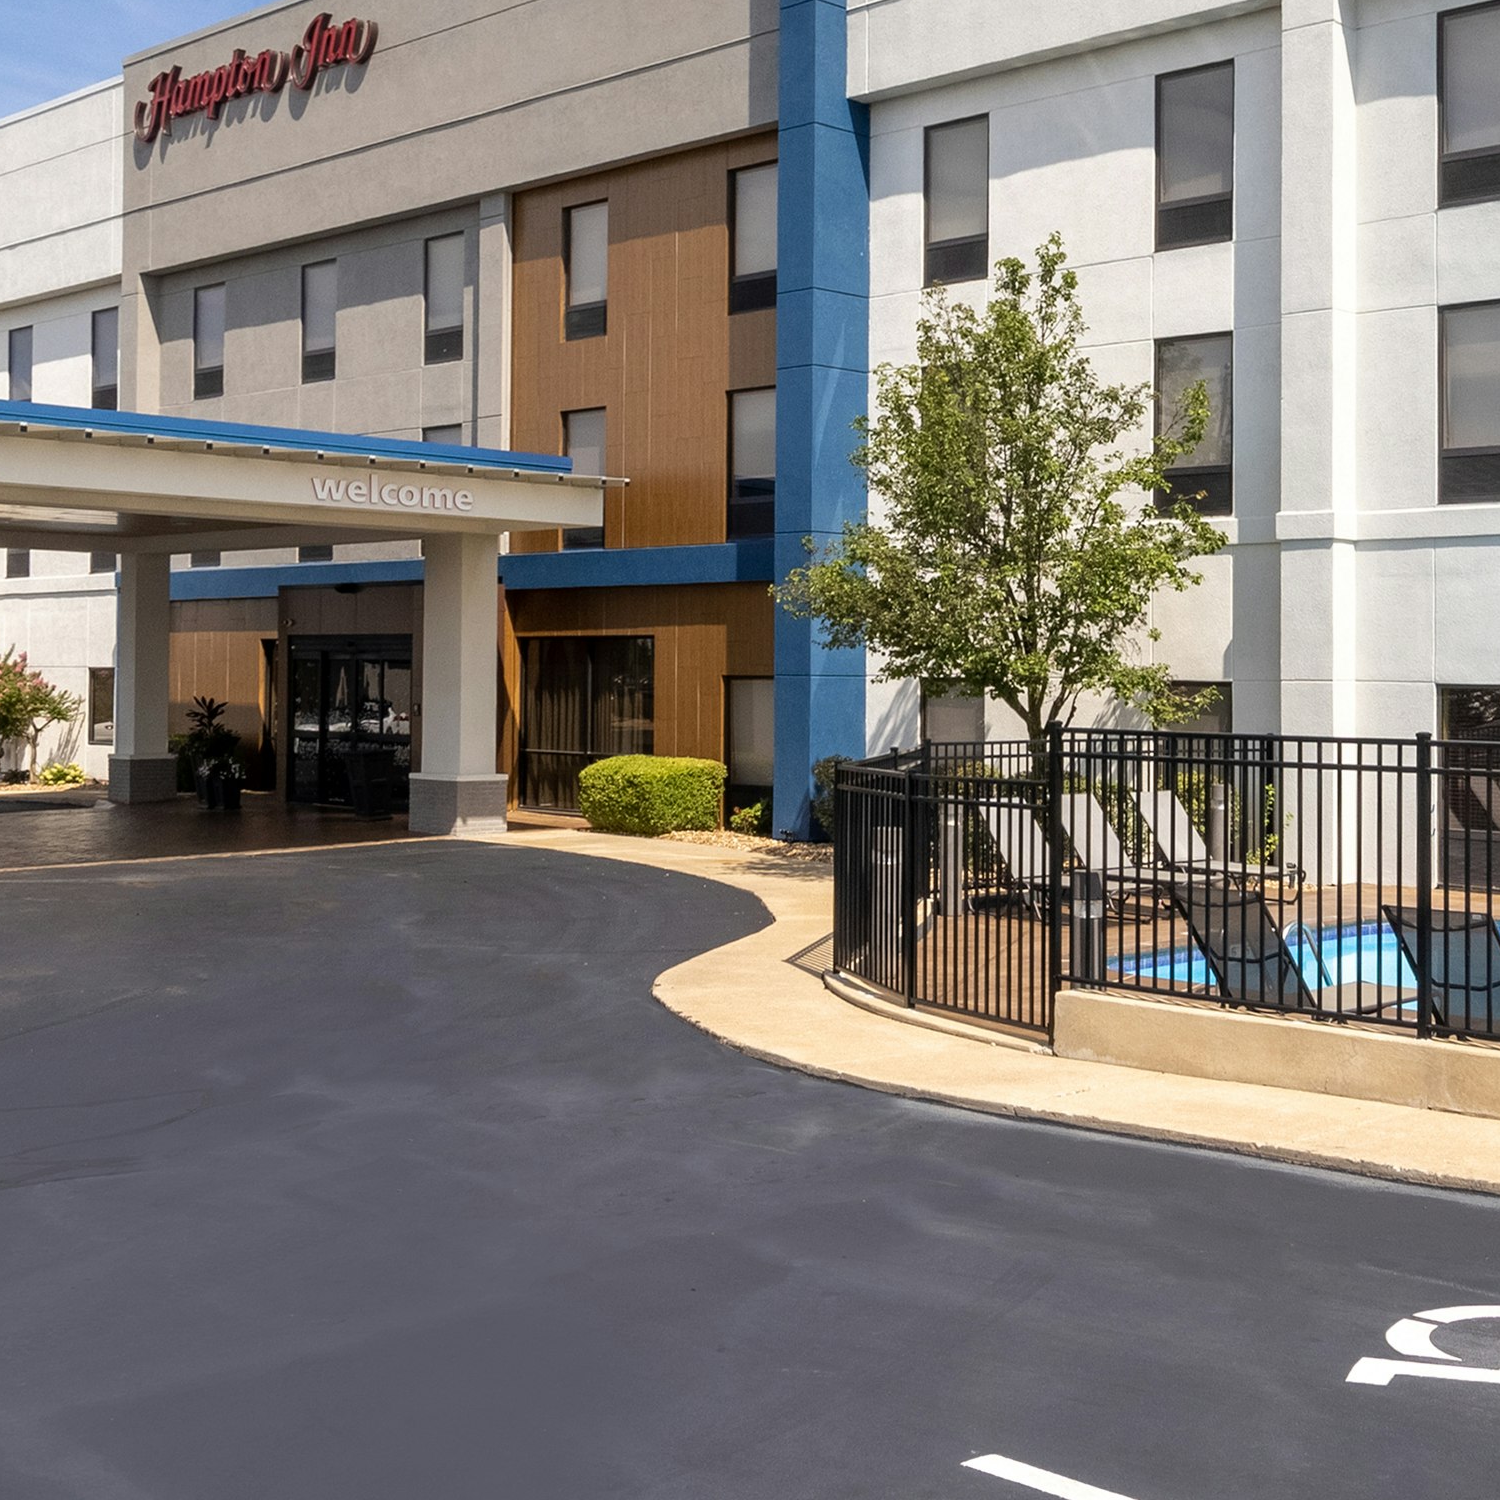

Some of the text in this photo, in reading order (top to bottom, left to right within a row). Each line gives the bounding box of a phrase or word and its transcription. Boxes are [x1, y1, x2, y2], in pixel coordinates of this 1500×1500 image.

[134, 12, 378, 142] Hampton Inn
[312, 474, 474, 511] welcome
